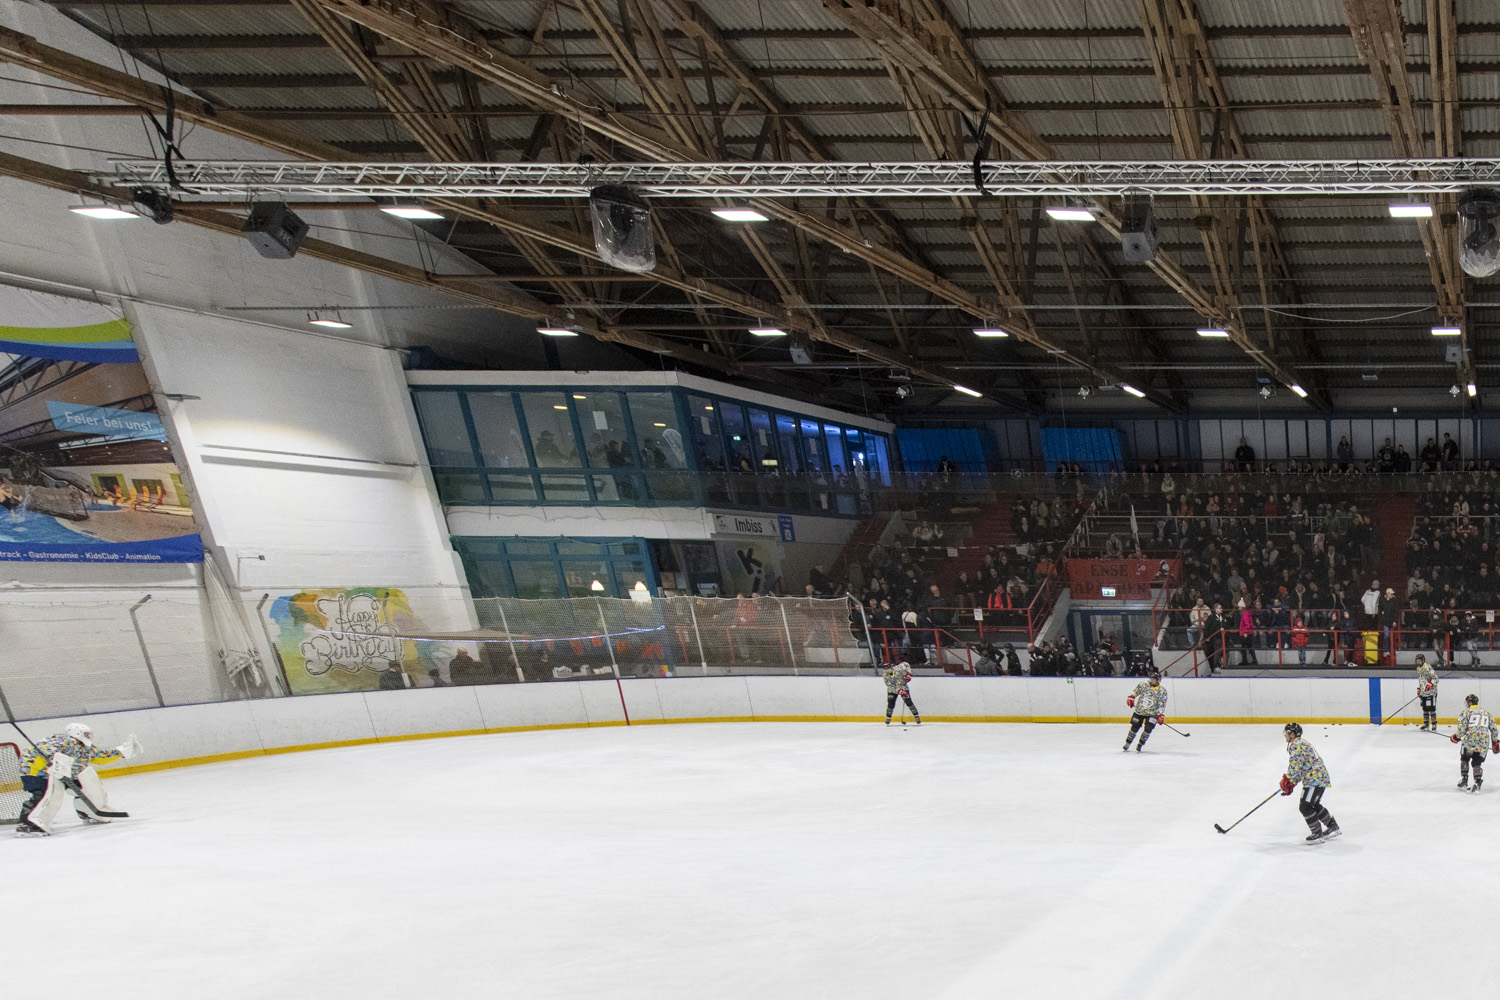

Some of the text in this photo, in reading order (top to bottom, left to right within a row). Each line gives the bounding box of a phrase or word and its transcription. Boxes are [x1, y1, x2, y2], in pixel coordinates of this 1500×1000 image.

[64, 411, 152, 432] Feier bei uns!
[735, 517, 763, 534] Imbiss
[29, 551, 79, 560] Gastronomie
[85, 552, 119, 560] KidsClub
[126, 553, 161, 561] Animation
[315, 593, 382, 640] Happy
[1468, 714, 1490, 728] 90
